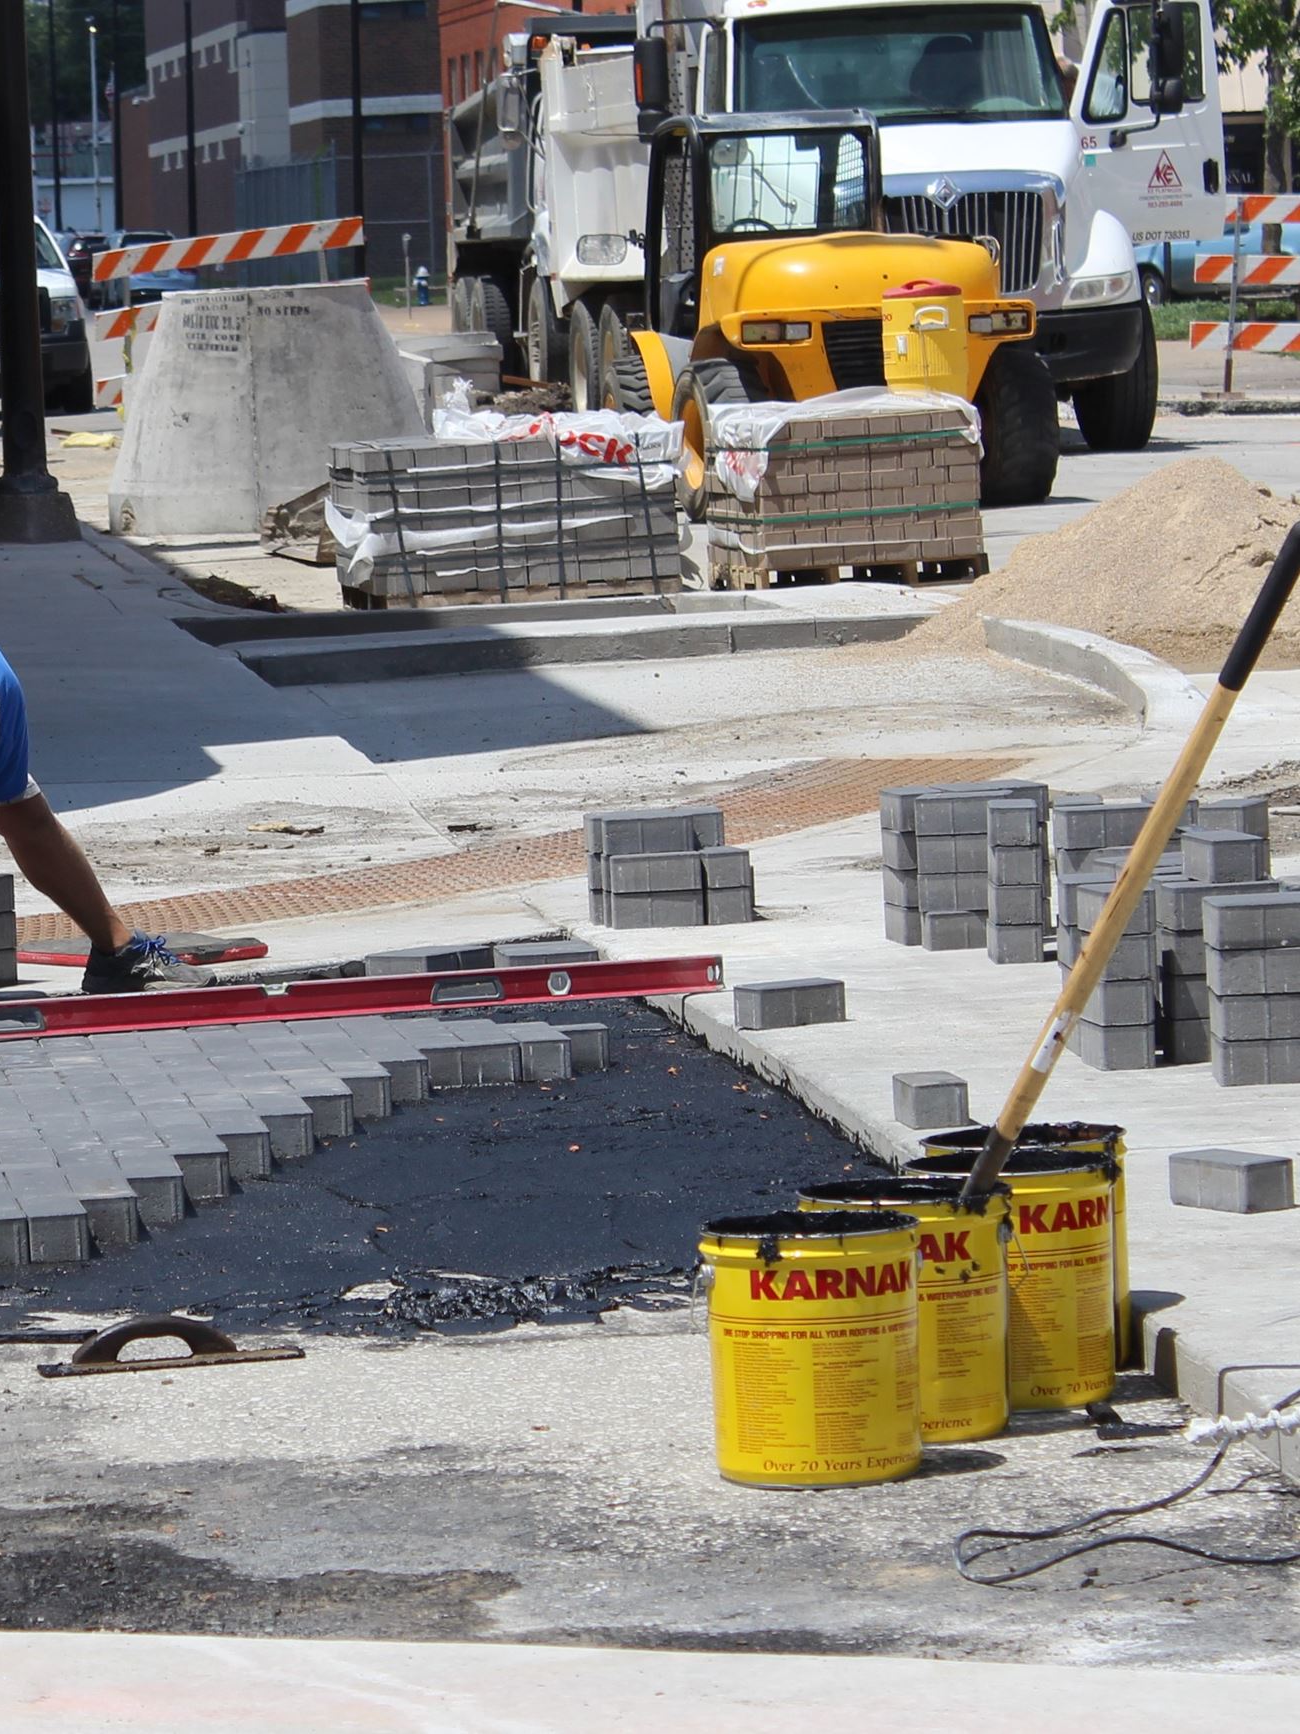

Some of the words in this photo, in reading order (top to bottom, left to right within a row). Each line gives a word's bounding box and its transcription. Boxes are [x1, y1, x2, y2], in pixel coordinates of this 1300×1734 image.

[1132, 231, 1144, 241] US
[1145, 231, 1161, 241] DOT
[256, 306, 272, 316] NO
[275, 305, 311, 316] STEPS
[750, 1260, 913, 1300] KARNAK
[734, 1329, 750, 1338] STOP
[752, 1330, 790, 1339] SHOPPING
[791, 1330, 808, 1340] FOR
[810, 1330, 824, 1339] ALL
[827, 1329, 848, 1338] YOUR
[1031, 1385, 1060, 1397] Over
[1066, 1382, 1081, 1393] 70
[763, 1459, 795, 1472] Over
[801, 1460, 819, 1472] 70
[824, 1458, 862, 1472] Years
